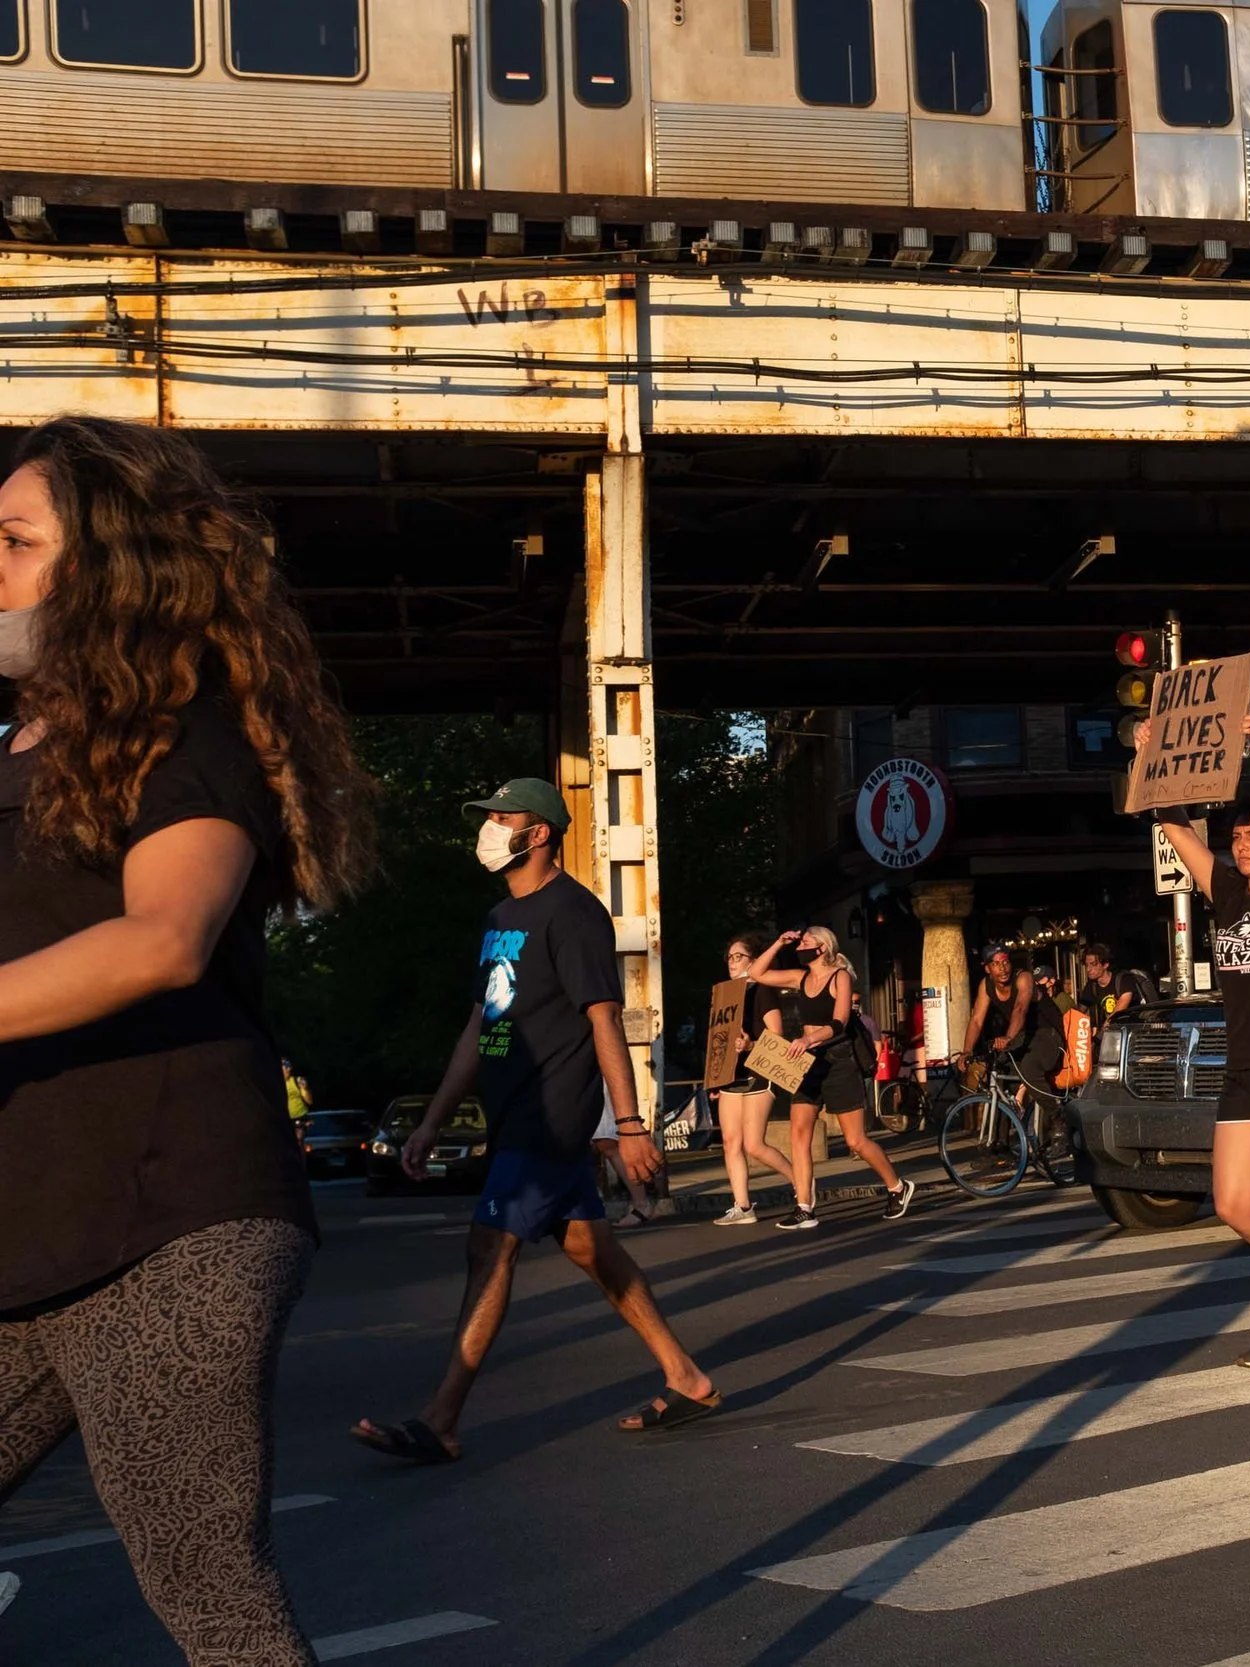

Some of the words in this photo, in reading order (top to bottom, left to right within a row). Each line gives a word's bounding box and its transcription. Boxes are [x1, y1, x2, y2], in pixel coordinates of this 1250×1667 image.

[1161, 712, 1227, 751] LIVES
[864, 760, 937, 793] HOUNDSTOOTH
[1144, 749, 1226, 782] MATTER
[880, 847, 922, 867] SALOON
[1159, 848, 1177, 865] WA
[922, 999, 942, 1009] PECIALS
[759, 1034, 778, 1051] NO
[1076, 1017, 1091, 1072] caviar
[752, 1054, 770, 1069] NO
[769, 1064, 801, 1089] PEACE
